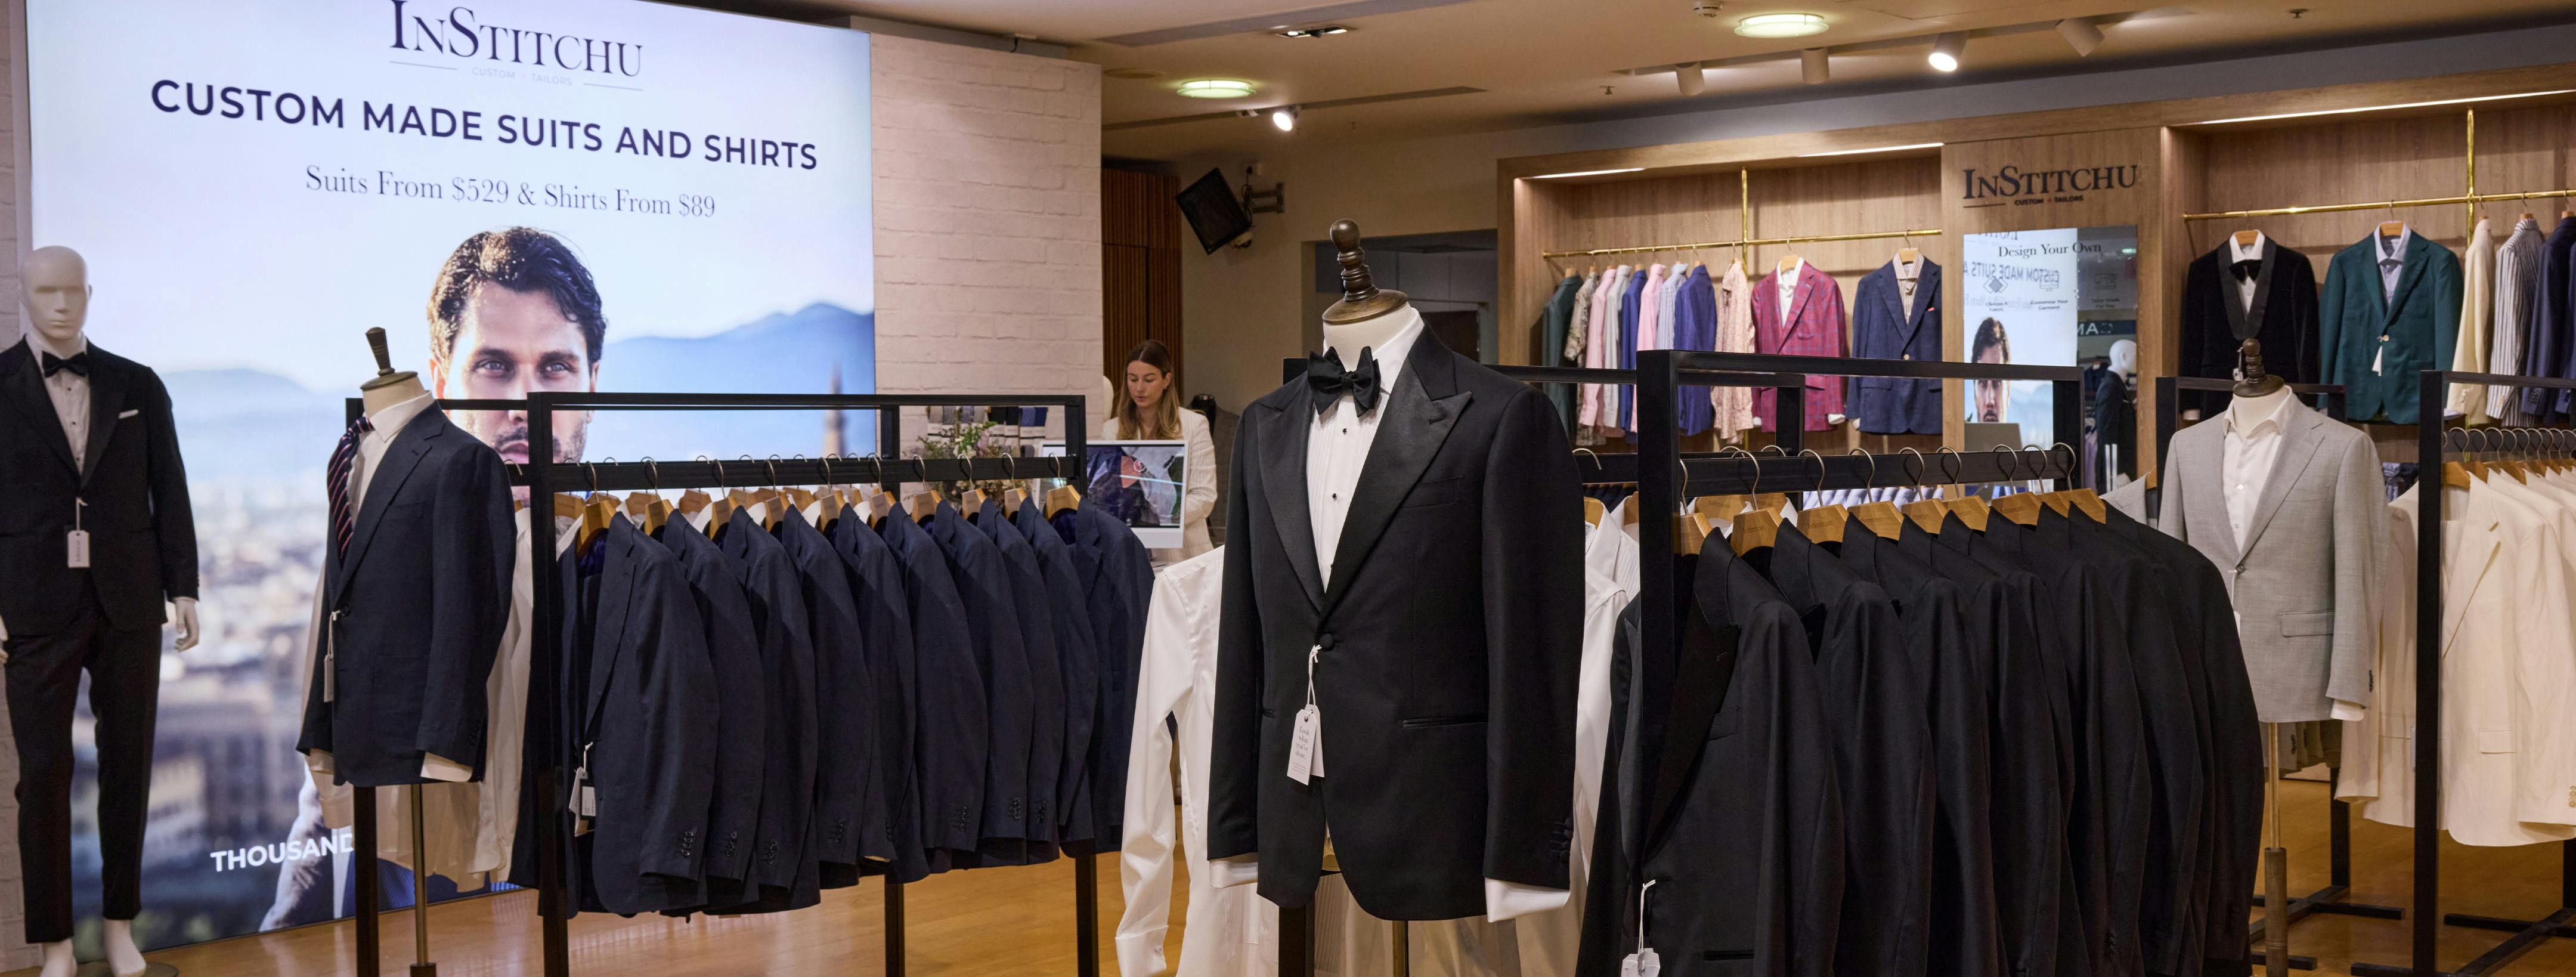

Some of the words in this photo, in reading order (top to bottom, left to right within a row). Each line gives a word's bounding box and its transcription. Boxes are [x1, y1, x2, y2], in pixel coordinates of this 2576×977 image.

[472, 66, 515, 79] CUSTOM
[531, 73, 572, 86] TAILORS
[151, 79, 344, 128] CUSTOM
[363, 100, 482, 141] MADE
[497, 115, 602, 152] SUITS
[616, 126, 691, 159] AND
[704, 135, 817, 170] SHIRTS
[306, 165, 368, 194] Suits
[376, 170, 443, 199] From
[451, 177, 509, 203] $529
[518, 181, 537, 206] &
[544, 183, 608, 211] Shirts
[615, 188, 672, 215] From
[678, 193, 715, 218] $89
[1999, 245, 2037, 258] Design
[2041, 244, 2069, 255] Your
[2072, 242, 2101, 253] Own
[1299, 726, 1310, 736] Look
[210, 833, 355, 872] THOUSAND
